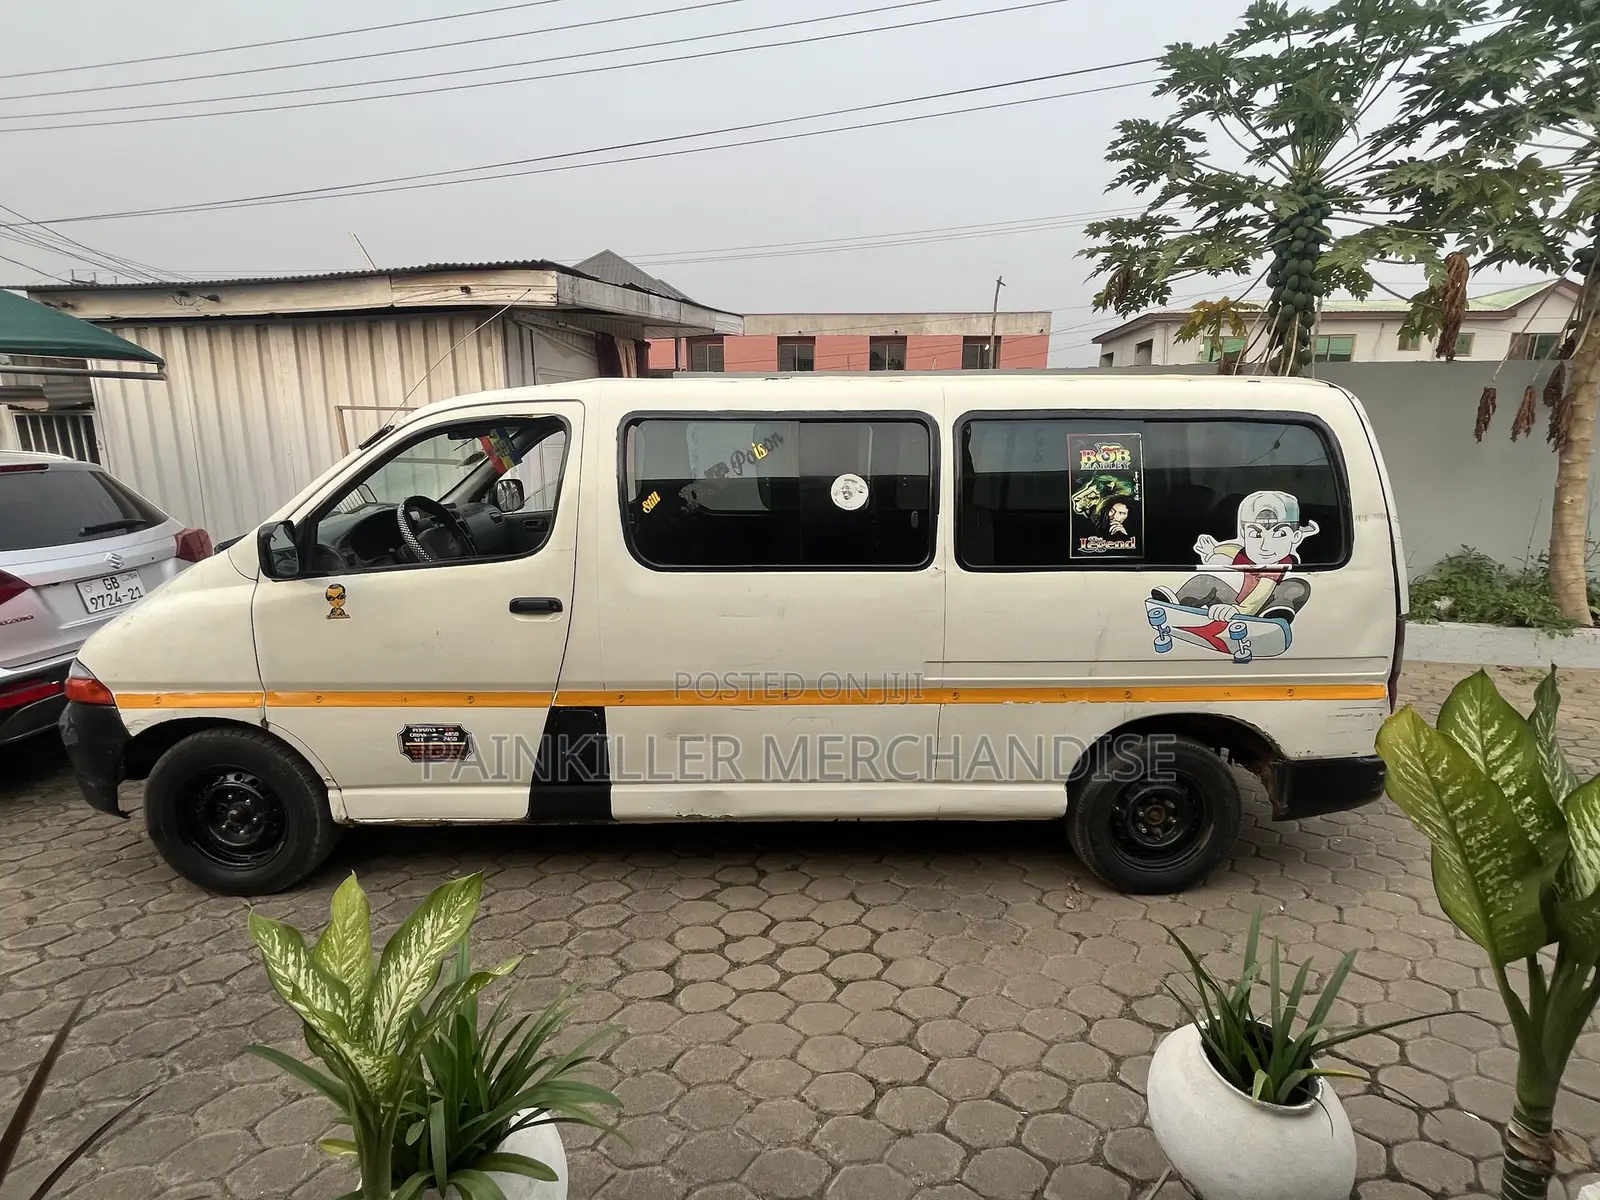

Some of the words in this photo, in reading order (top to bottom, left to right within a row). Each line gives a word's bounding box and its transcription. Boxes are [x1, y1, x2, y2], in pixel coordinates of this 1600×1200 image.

[1079, 450, 1131, 463] BOB
[1080, 461, 1131, 471] MARLEY
[641, 490, 661, 514] Still
[1078, 536, 1136, 553] Legend
[102, 576, 120, 591] GB
[90, 586, 144, 610] 9724-21
